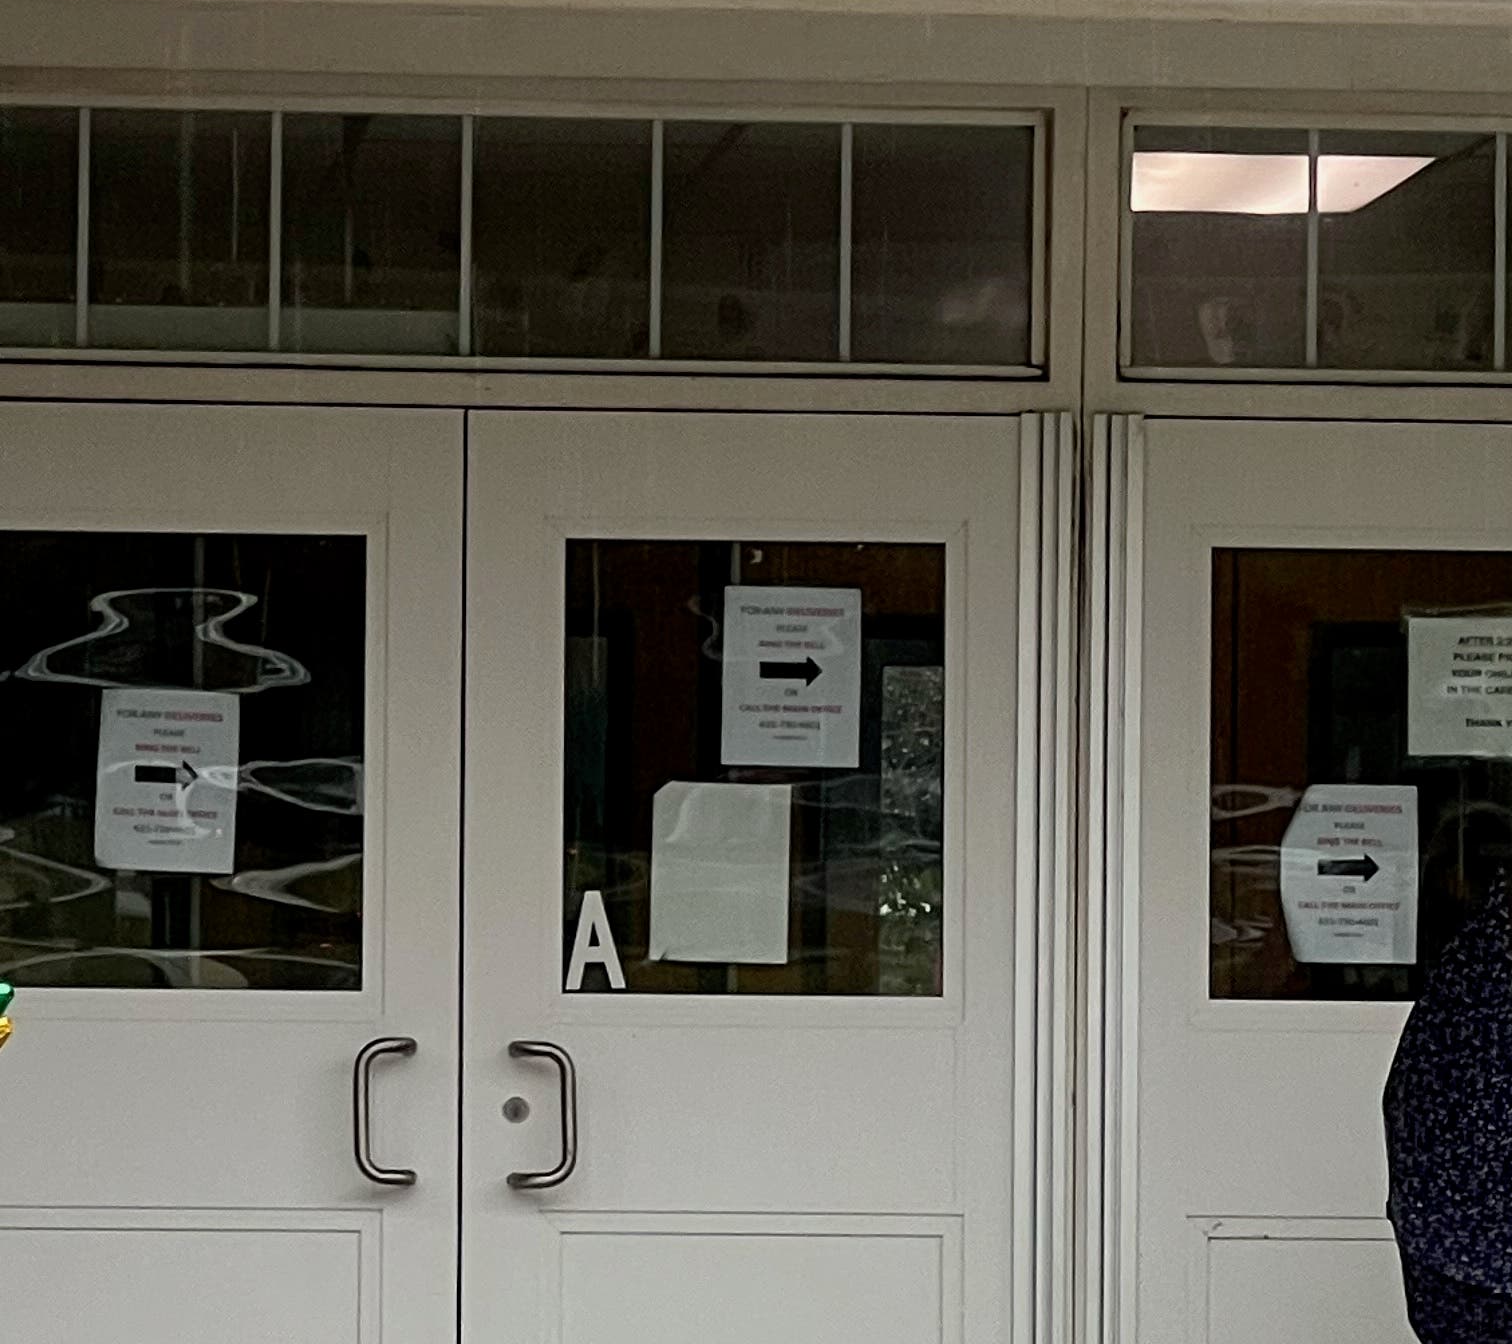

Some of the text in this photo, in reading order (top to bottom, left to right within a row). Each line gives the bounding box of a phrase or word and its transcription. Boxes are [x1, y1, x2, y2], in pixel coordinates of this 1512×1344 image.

[1453, 652, 1494, 662] PLEASE
[1465, 718, 1503, 729] THANK
[565, 889, 627, 991] A
